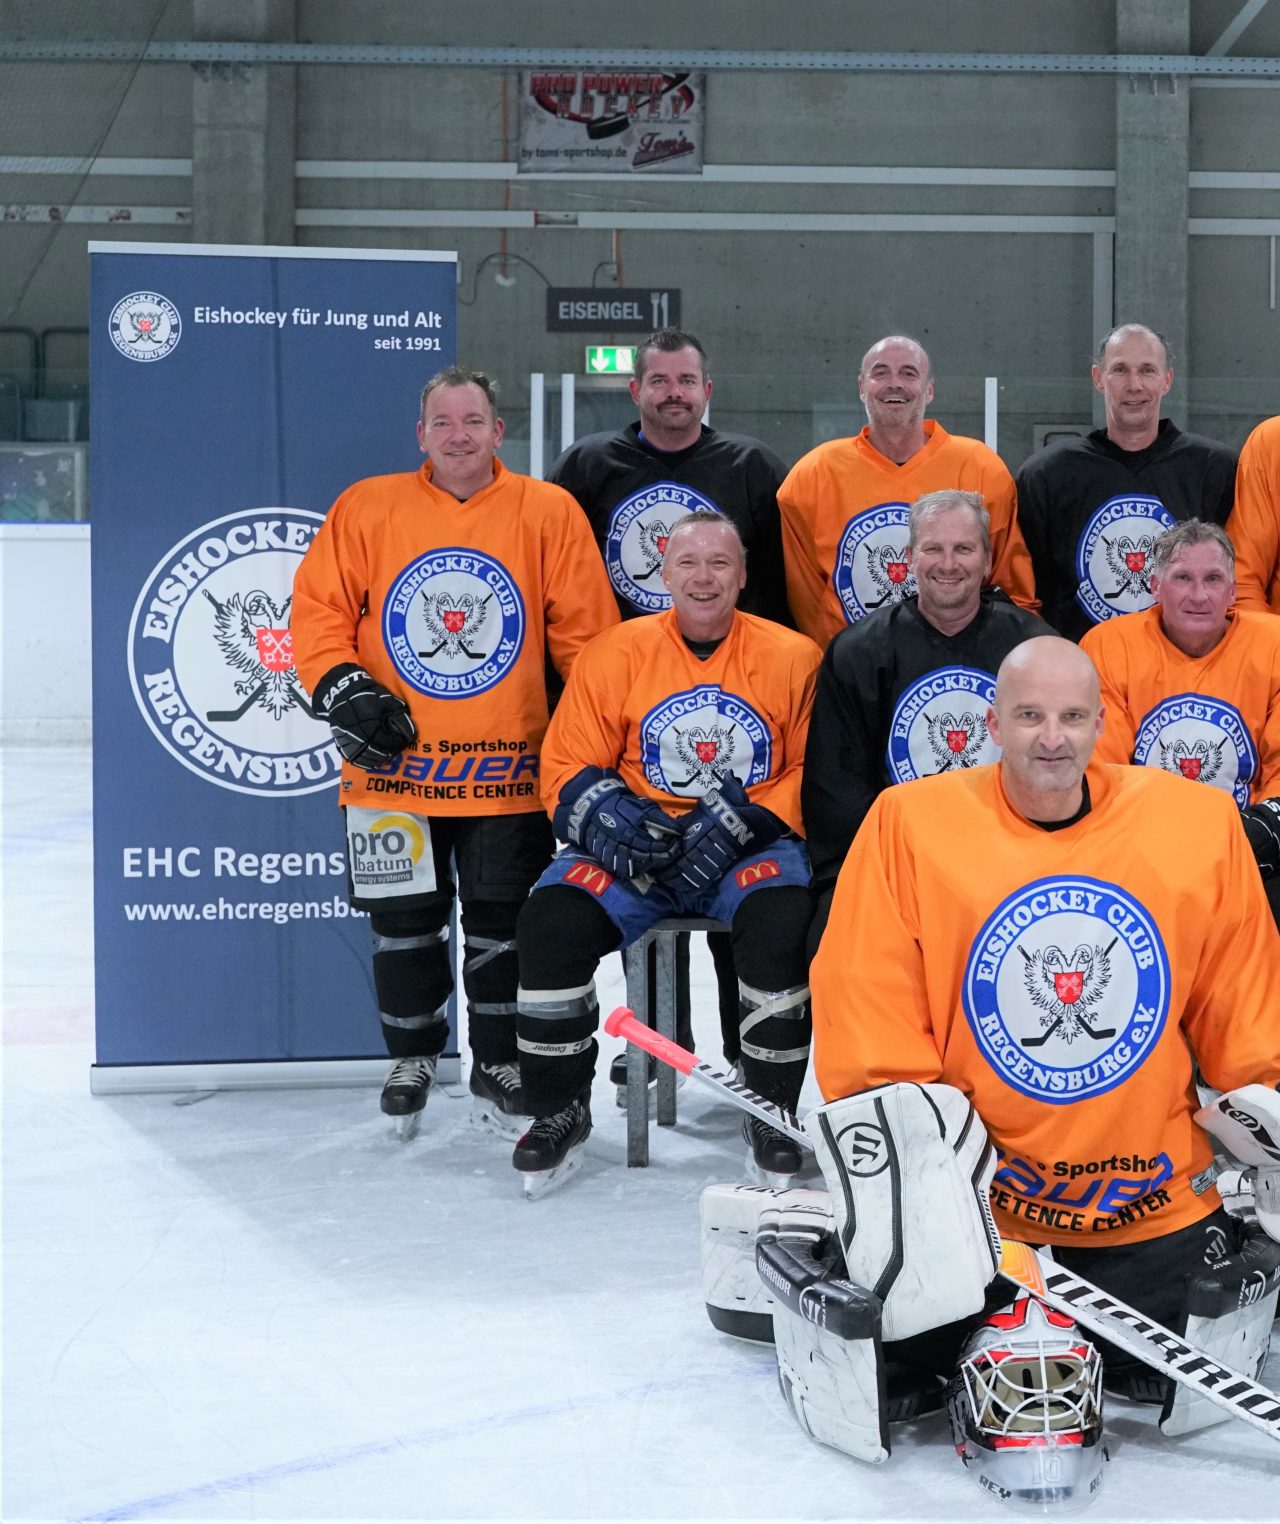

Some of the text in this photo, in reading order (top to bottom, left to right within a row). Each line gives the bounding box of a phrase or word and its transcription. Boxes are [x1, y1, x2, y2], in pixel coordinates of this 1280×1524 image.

[530, 72, 664, 95] PRO POWER
[556, 94, 686, 118] HOCKEY
[521, 146, 627, 160] by toms-sportshop.de
[112, 294, 179, 325] EISHOCKEY CLUB
[194, 307, 442, 330] Eishockey für Jung und Alt
[558, 302, 643, 320] EISENGEL
[112, 330, 171, 359] REGENSBURG
[374, 336, 441, 350] seit 1991
[611, 489, 693, 542] EISHOCKEY
[842, 511, 909, 568] EISHOCKE
[143, 521, 320, 643] EISHOCKE
[393, 556, 516, 617] EISHOCKEY CLUB
[609, 559, 673, 609] REGENSB
[392, 634, 498, 691] REGENSBURG
[648, 692, 764, 746] EISHOCKE CLUB
[894, 675, 981, 739] EISHOCKEY
[144, 669, 342, 786] REGENSBU
[438, 740, 528, 755] Sportshop
[1134, 702, 1246, 763] EISHOCKEY CLUB
[366, 778, 534, 800] COMPETENCE CENTER
[702, 789, 755, 846] STON
[123, 847, 346, 884] EHC Regens
[351, 831, 405, 871] pro
[357, 857, 413, 872] batum
[377, 872, 411, 883] systems
[977, 889, 1155, 984] EISHOCKEY CLUB
[980, 1012, 1132, 1091] REGENSBURG
[1053, 1154, 1158, 1180] Sportsho
[989, 1186, 1172, 1233] PETENCE CENTER
[760, 1255, 792, 1297] WARRIOR
[979, 1474, 1013, 1499] REY
